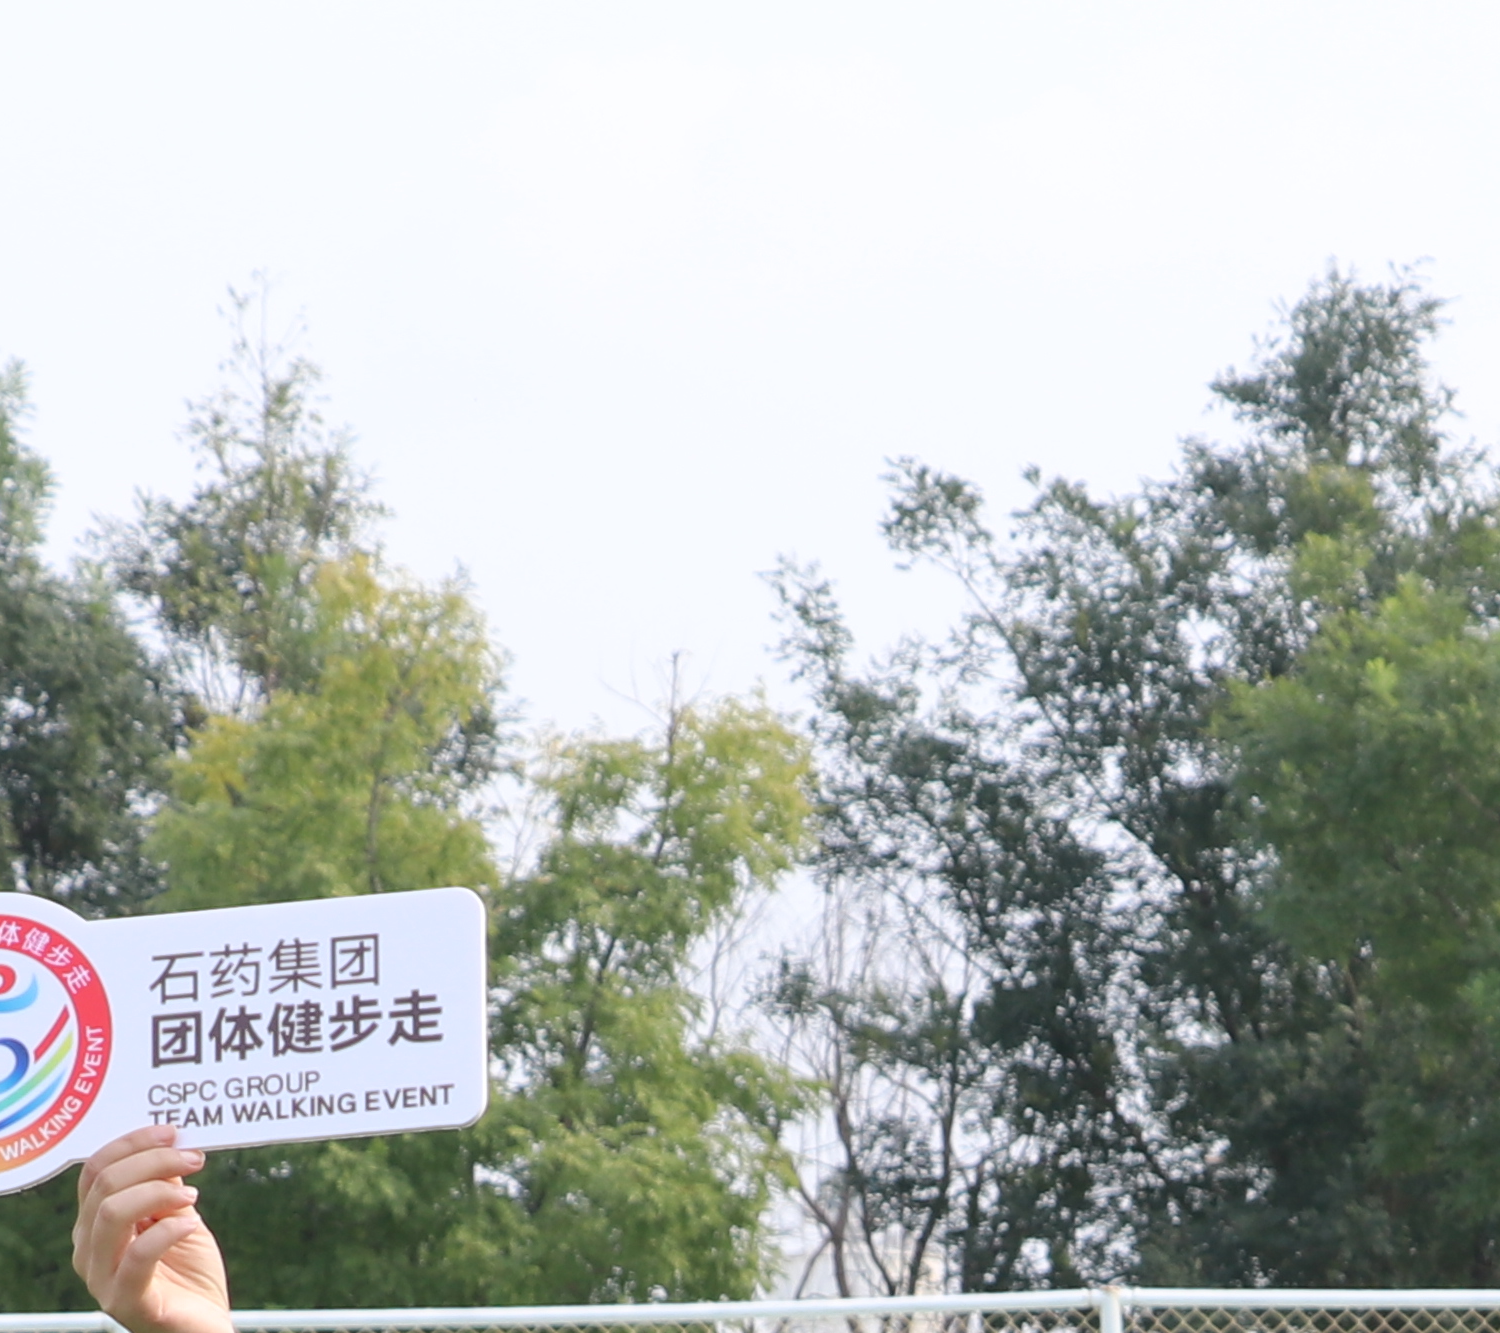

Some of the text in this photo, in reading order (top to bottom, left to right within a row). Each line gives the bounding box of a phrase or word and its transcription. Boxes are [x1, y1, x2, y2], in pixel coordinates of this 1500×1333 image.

[149, 933, 381, 1005] 石药集团
[74, 1026, 104, 1095] EVENT
[150, 989, 445, 1069] 团体健步走
[148, 1071, 321, 1107] CSPC GROUP
[149, 1084, 455, 1130] TEAM WALKING EVENT
